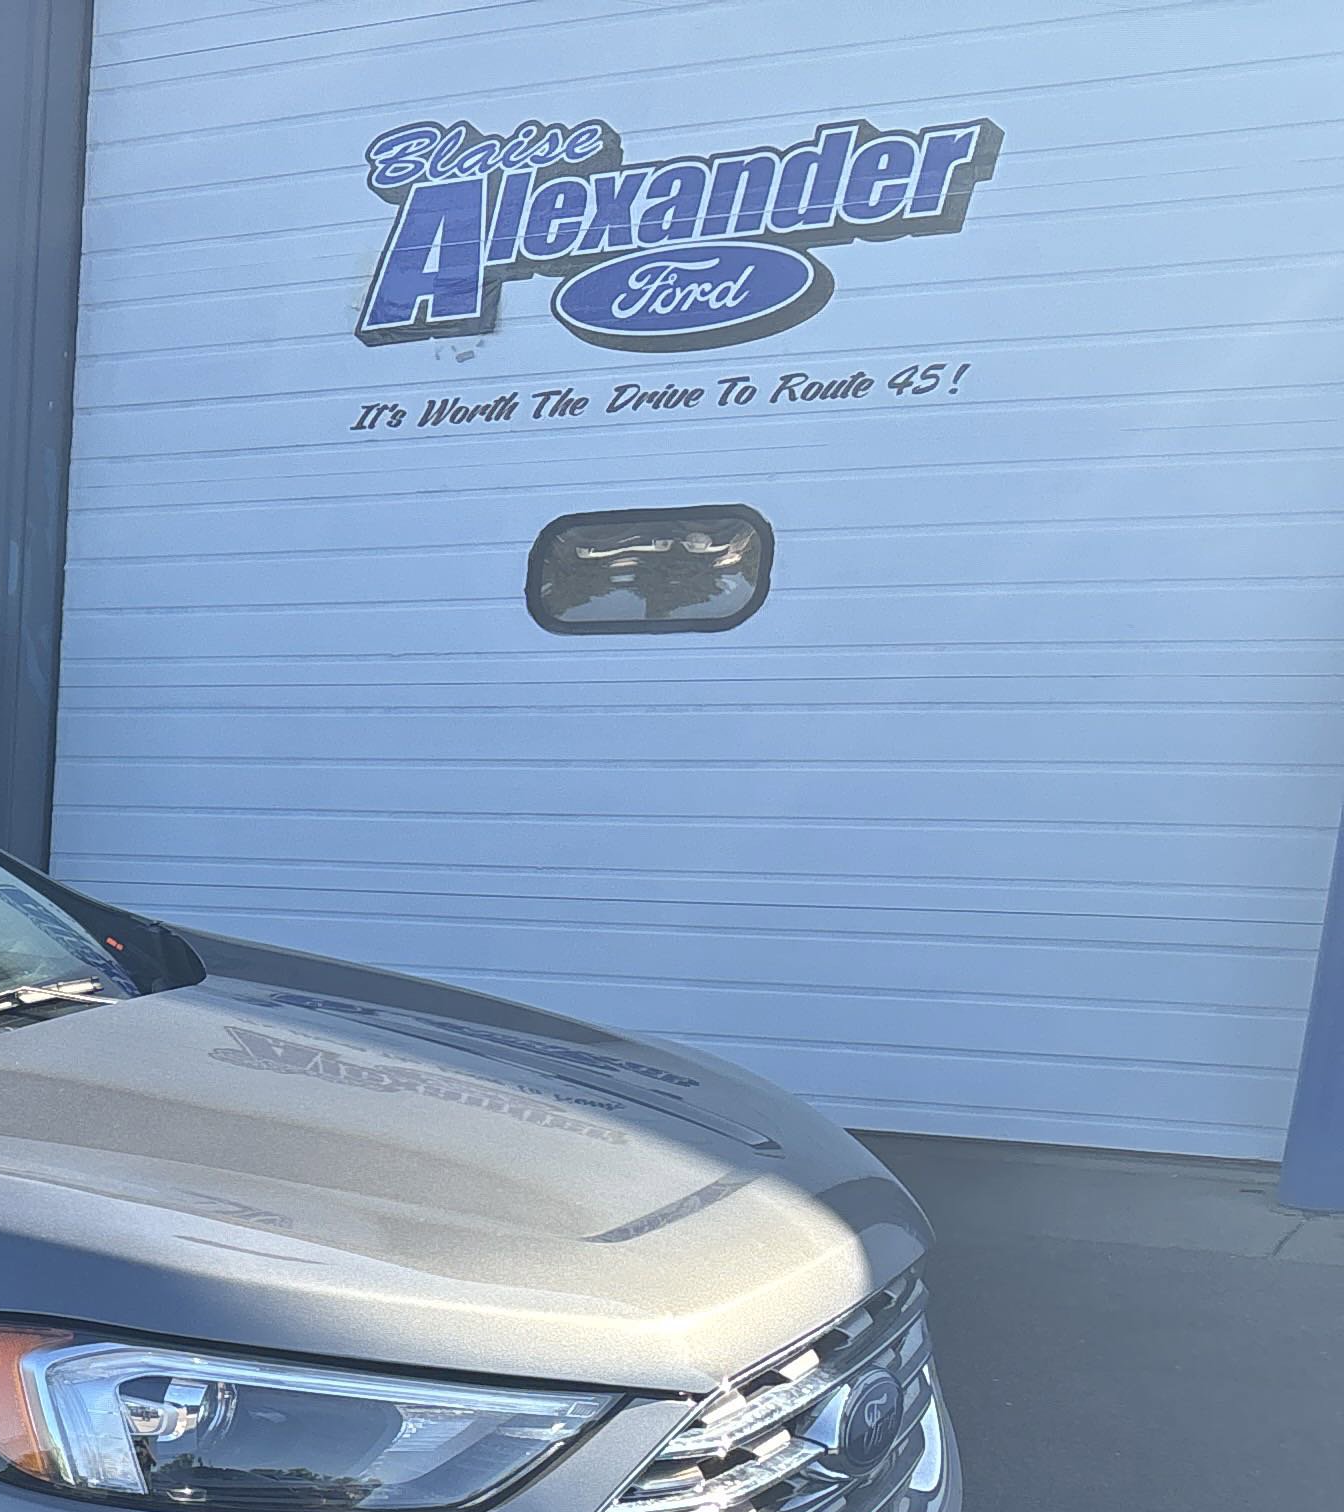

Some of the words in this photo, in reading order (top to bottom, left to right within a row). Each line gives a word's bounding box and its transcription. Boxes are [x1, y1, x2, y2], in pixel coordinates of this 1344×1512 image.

[368, 123, 607, 189] Blaise
[358, 120, 987, 334] Alexander
[611, 257, 755, 319] Ford
[349, 403, 407, 431] It's
[417, 392, 520, 428] Worth
[531, 388, 591, 420] The
[605, 383, 705, 413] Drive
[717, 376, 758, 406] To
[769, 371, 874, 403] Route
